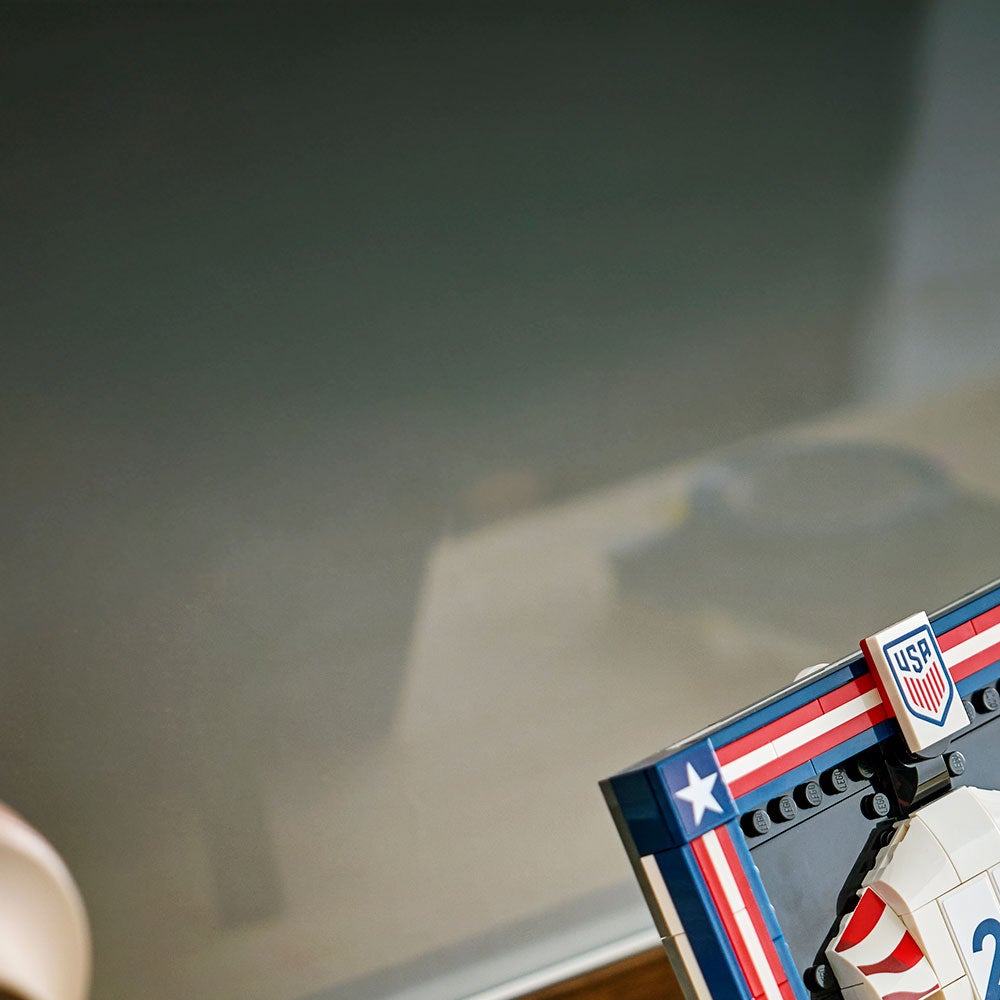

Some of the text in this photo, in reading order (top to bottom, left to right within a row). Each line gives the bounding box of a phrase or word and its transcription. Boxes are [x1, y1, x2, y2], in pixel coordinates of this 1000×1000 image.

[894, 638, 931, 673] USA
[834, 770, 848, 789] LEGO
[876, 794, 888, 814] LEGO
